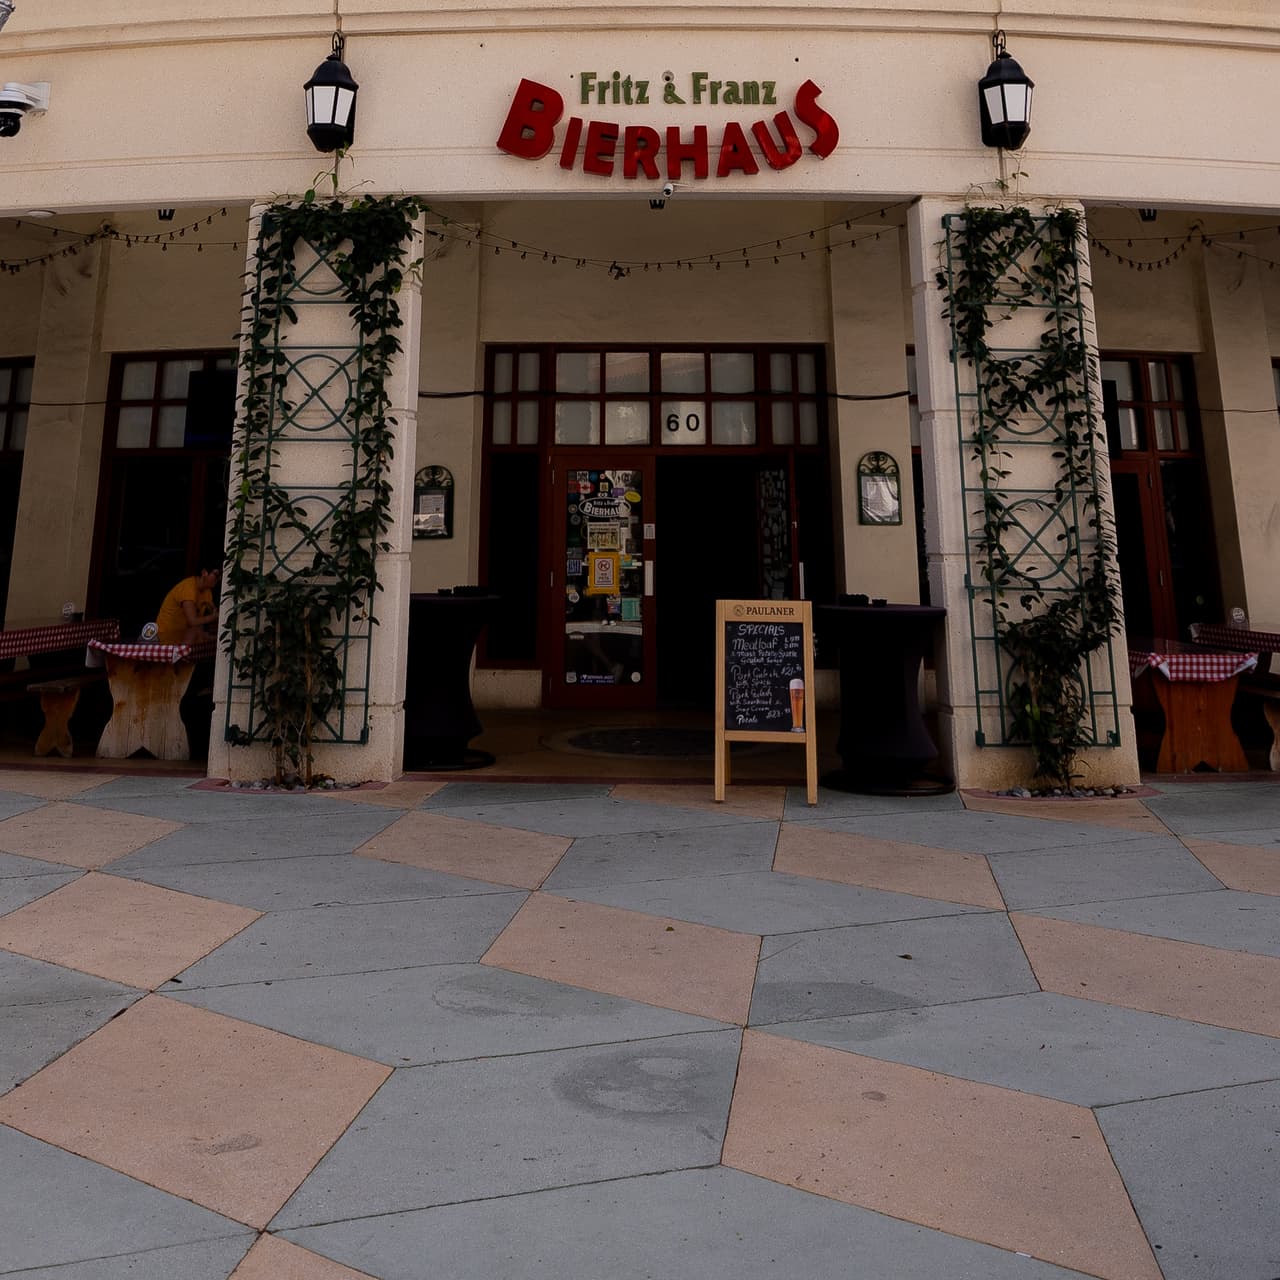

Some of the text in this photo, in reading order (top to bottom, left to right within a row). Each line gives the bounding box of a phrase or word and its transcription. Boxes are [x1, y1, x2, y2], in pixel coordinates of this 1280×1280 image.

[580, 71, 650, 105] Fritz
[691, 71, 777, 105] Franz
[496, 78, 840, 180] BIERHAUS
[666, 413, 701, 432] 60
[583, 501, 624, 517] BIERHAU
[746, 607, 795, 616] PAULANER
[738, 624, 786, 636] SPECIALS
